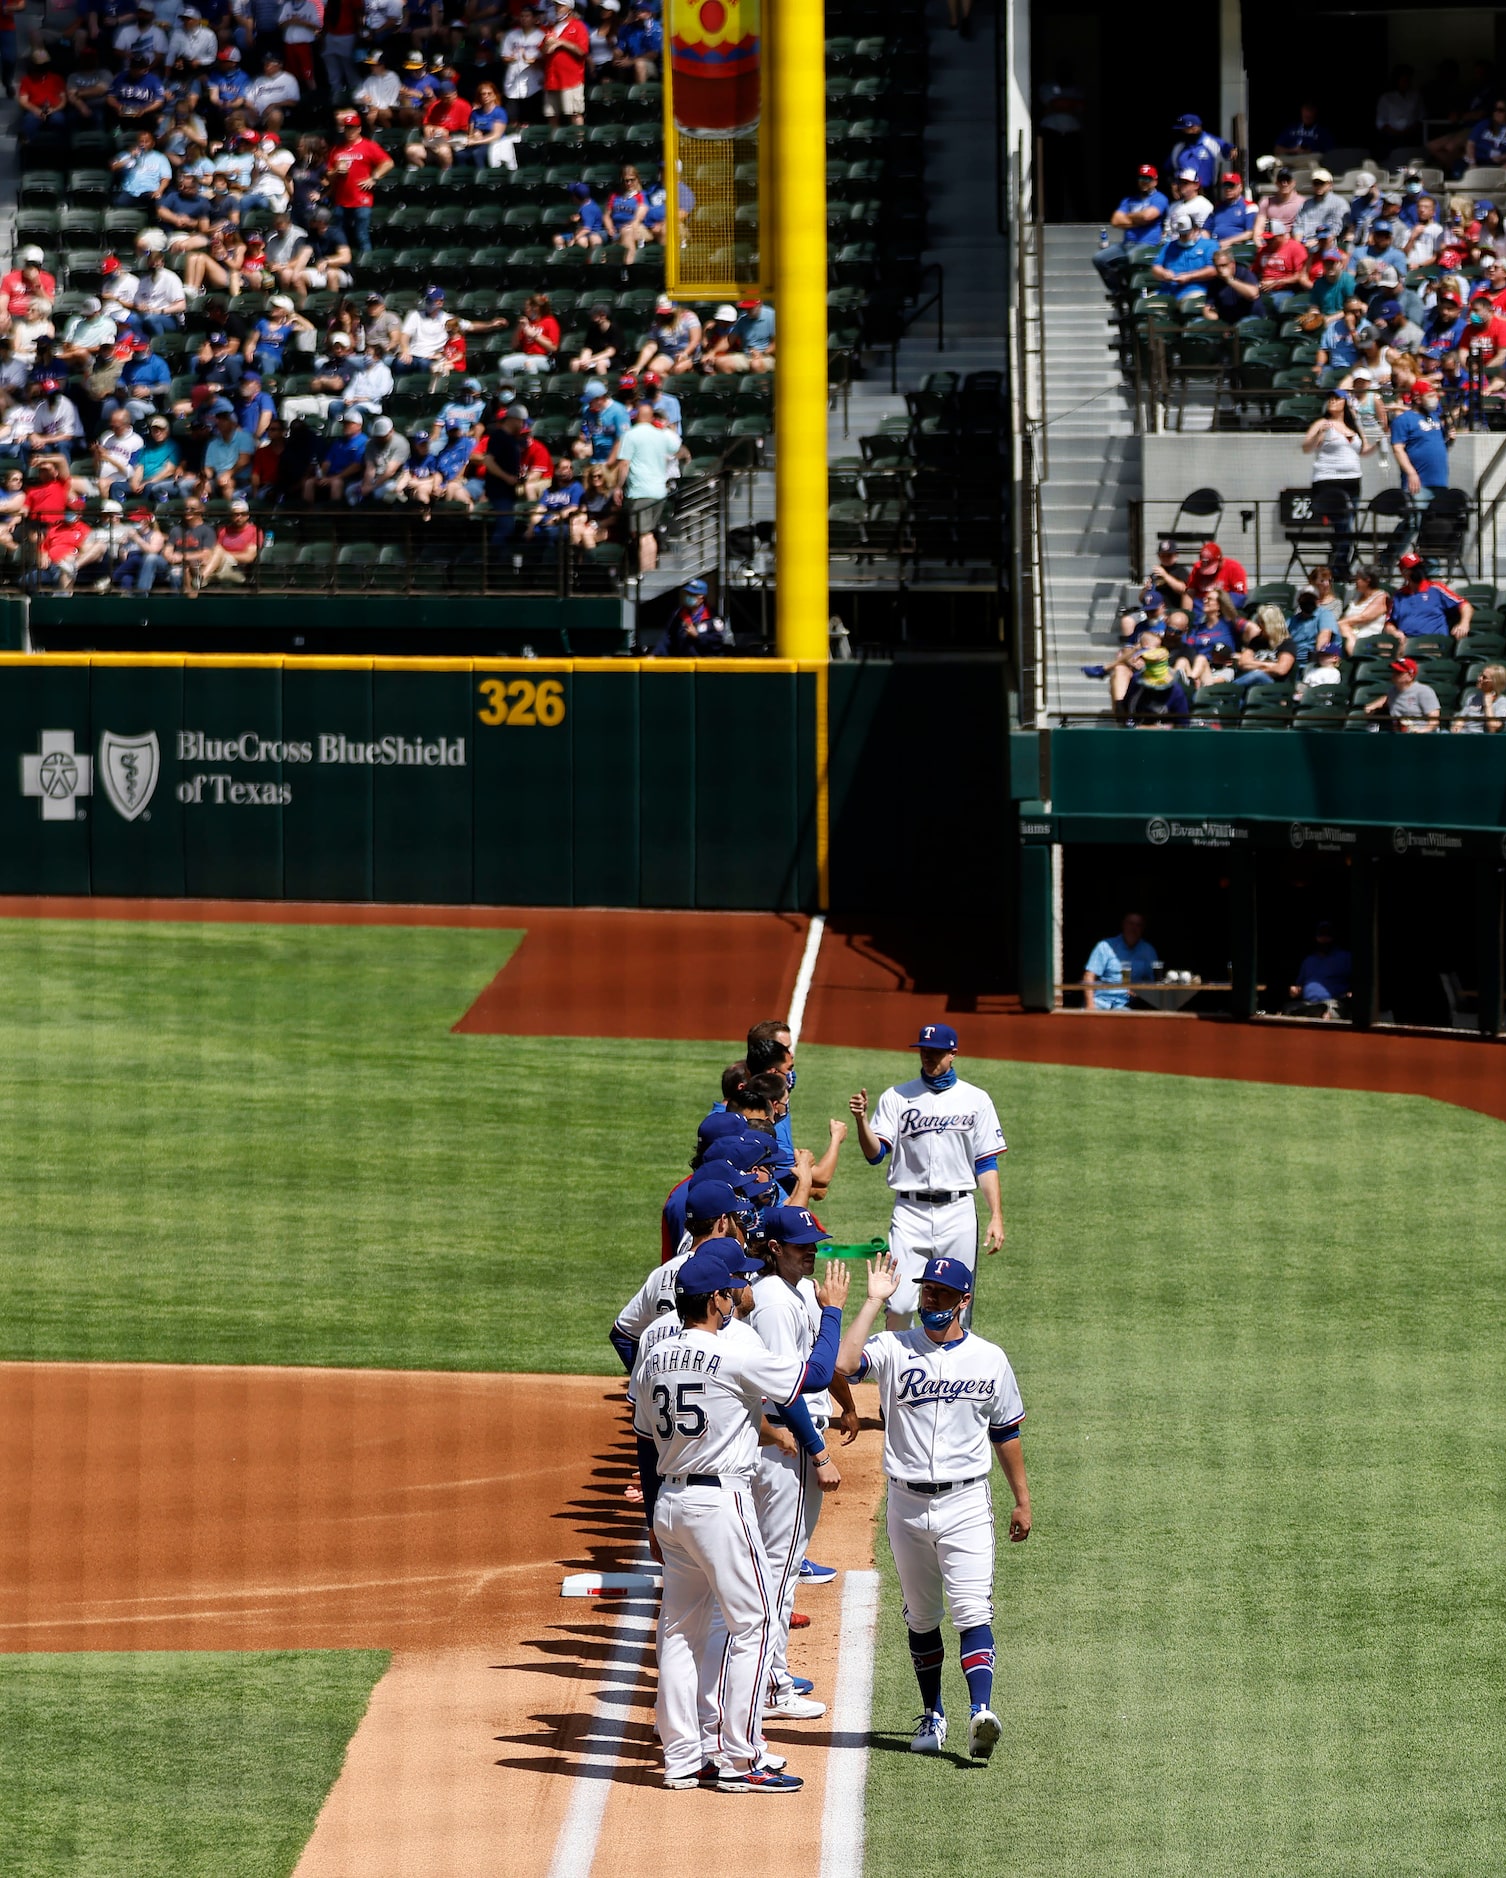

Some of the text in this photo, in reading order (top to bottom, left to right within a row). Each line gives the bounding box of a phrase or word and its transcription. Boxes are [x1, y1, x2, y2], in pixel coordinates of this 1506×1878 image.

[478, 679, 566, 727] 326
[176, 731, 467, 767] BlueCross BlueShield
[176, 775, 292, 805] of Texas
[924, 1026, 936, 1039] T
[900, 1108, 978, 1135] Rangers
[799, 1210, 813, 1227] T
[934, 1259, 951, 1276] T
[645, 1349, 722, 1378] ARIHARA
[897, 1368, 997, 1404] Rangers
[652, 1382, 708, 1440] 35
